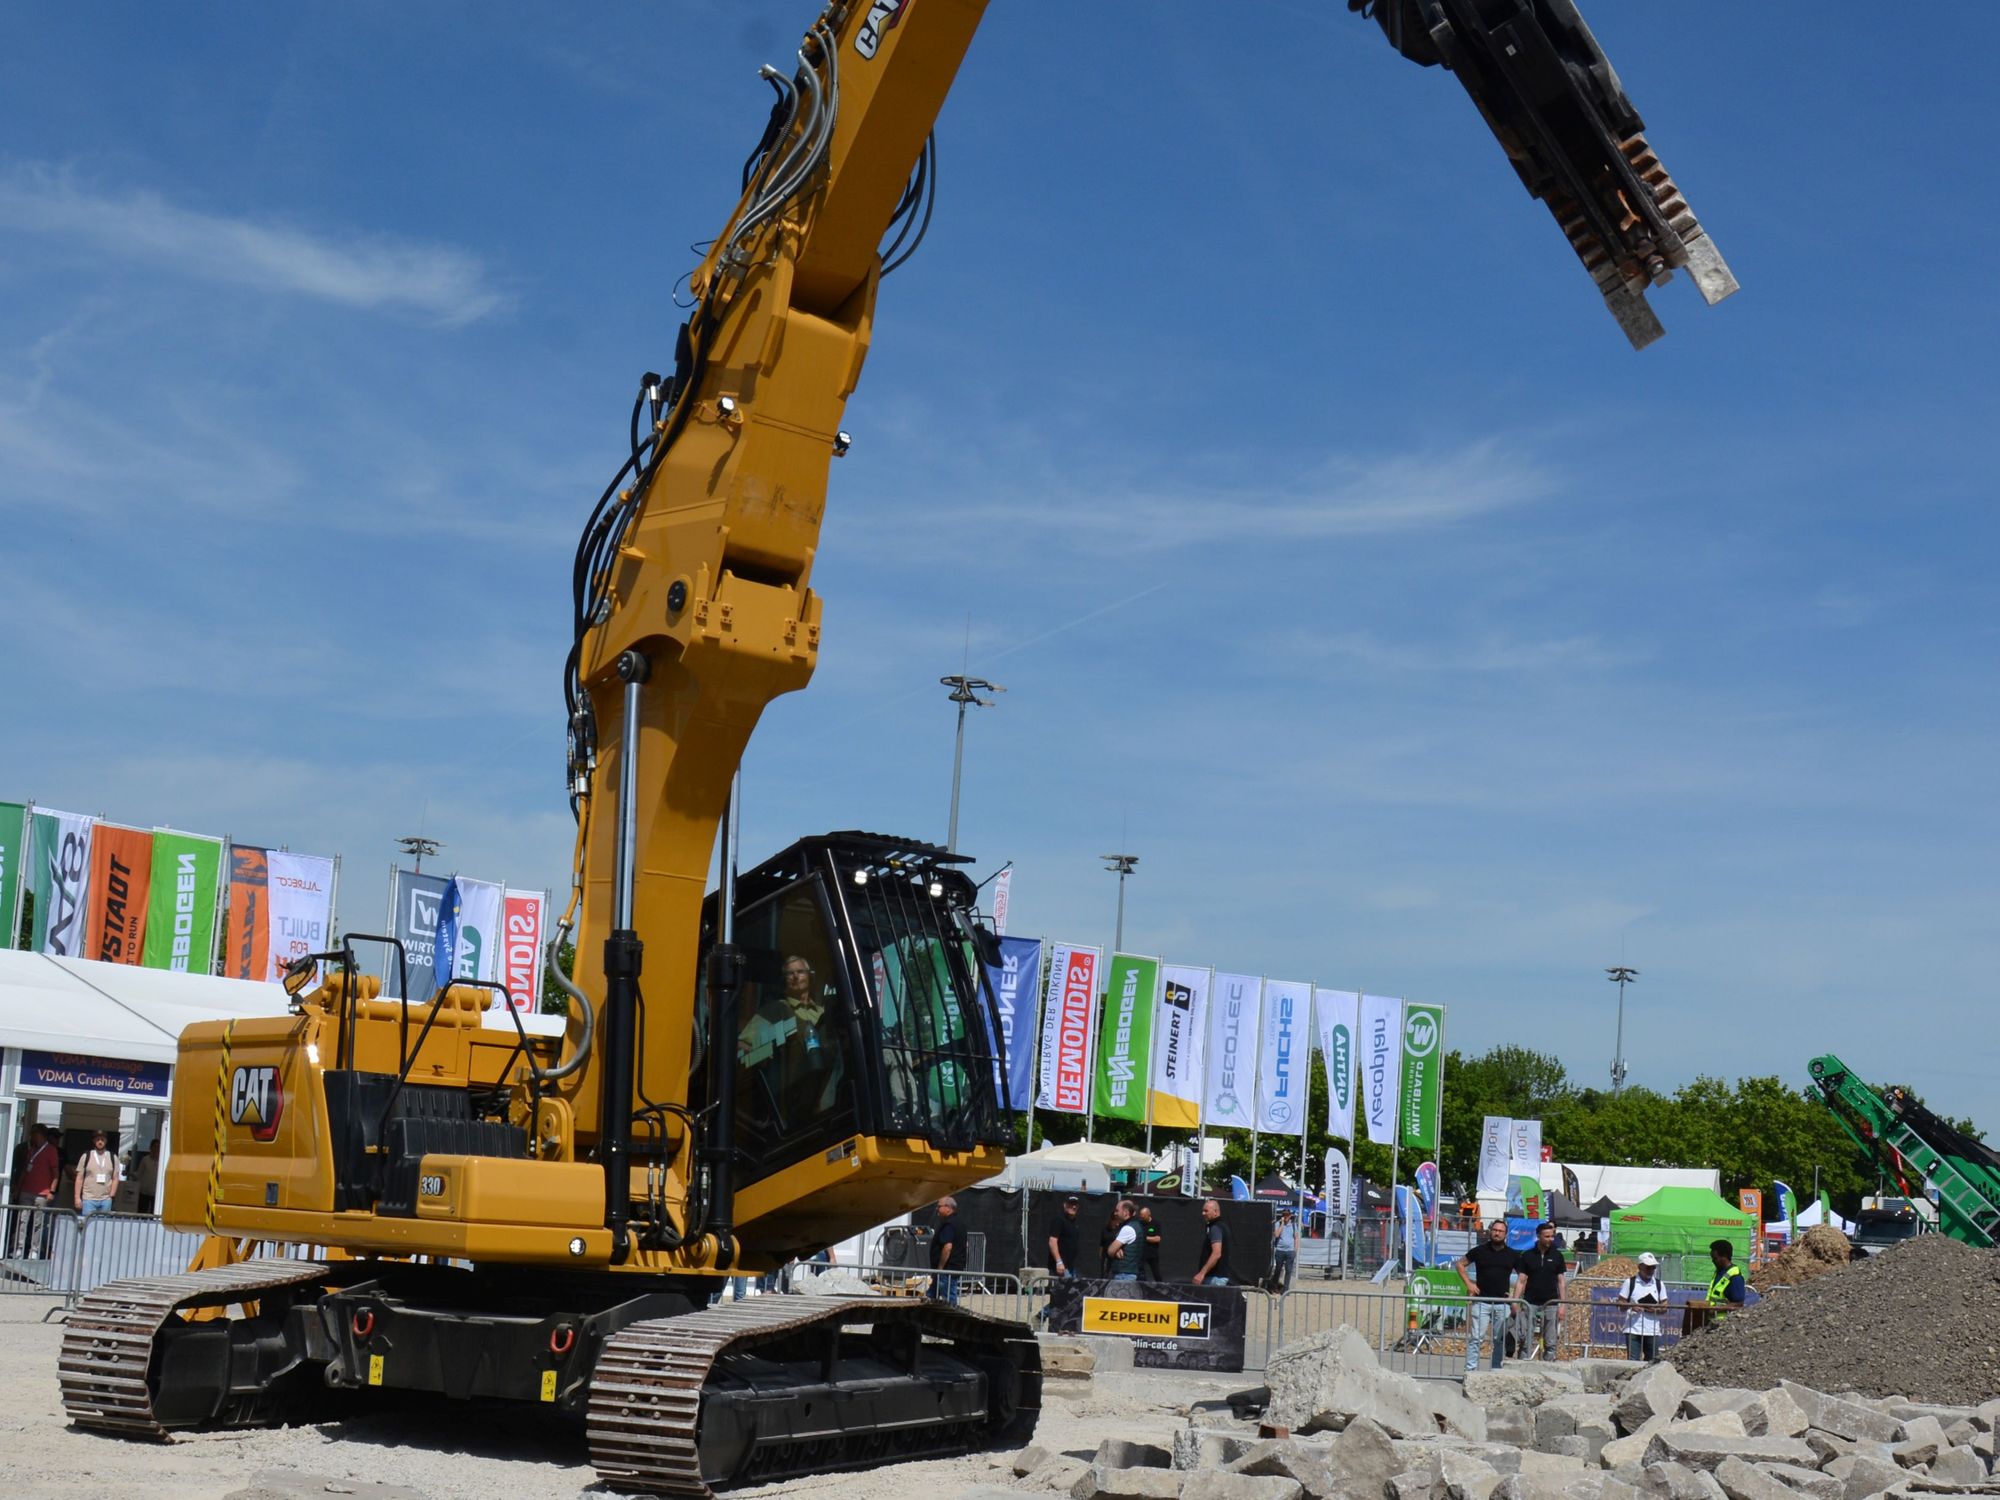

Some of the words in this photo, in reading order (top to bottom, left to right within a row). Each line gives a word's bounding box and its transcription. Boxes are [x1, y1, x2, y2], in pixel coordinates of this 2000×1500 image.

[129, 916, 138, 939] RUN
[128, 942, 136, 956] TO
[1166, 1010, 1181, 1079] STEINERT
[37, 1069, 74, 1085] VDMA
[77, 1073, 124, 1091] Crushing
[127, 1076, 154, 1091] Zone
[231, 1066, 273, 1125] CAT
[421, 1175, 442, 1195] 330
[1099, 1310, 1170, 1325] ZEPPELIN
[1180, 1311, 1207, 1330] CAT
